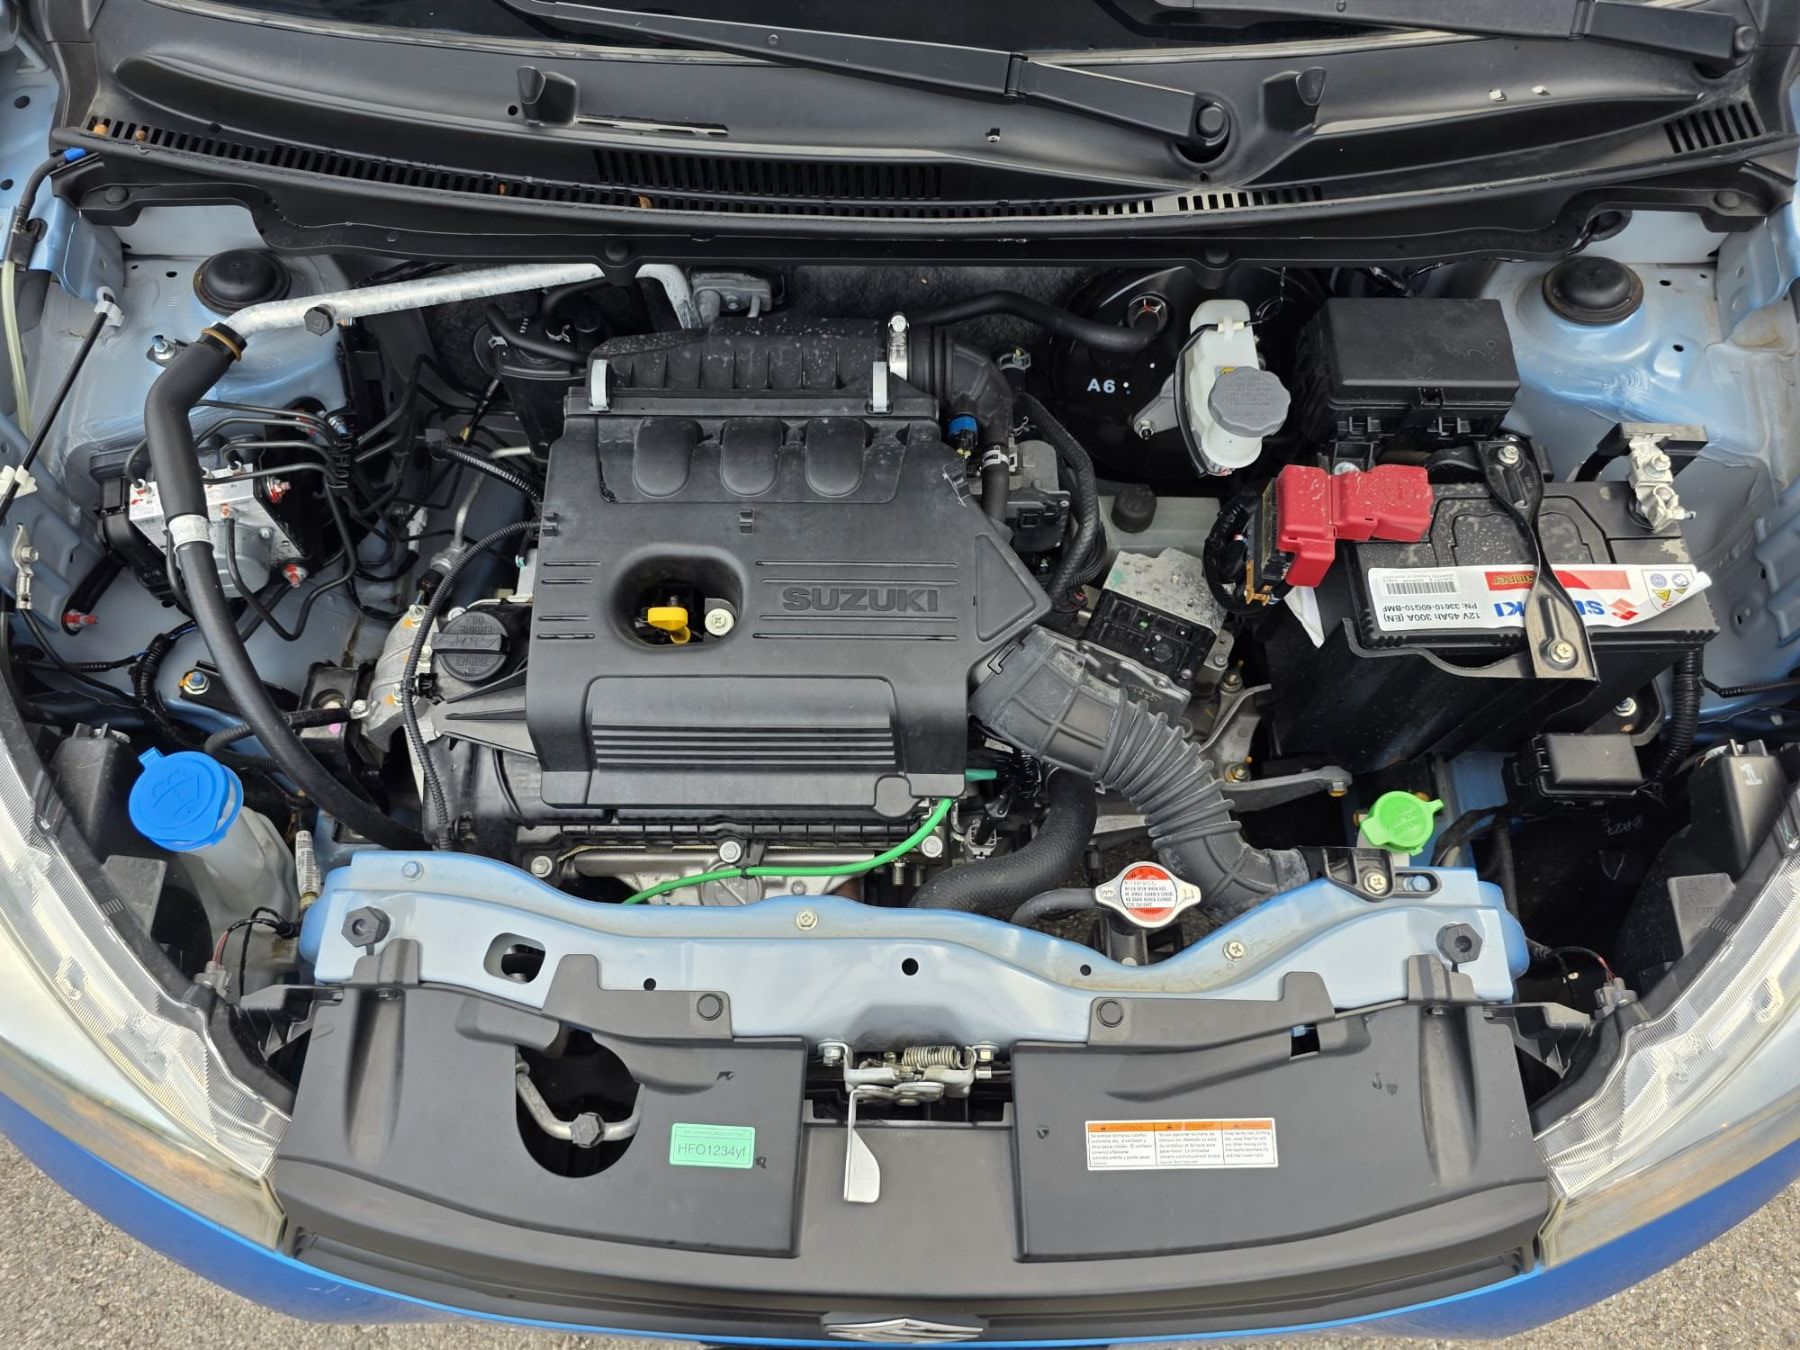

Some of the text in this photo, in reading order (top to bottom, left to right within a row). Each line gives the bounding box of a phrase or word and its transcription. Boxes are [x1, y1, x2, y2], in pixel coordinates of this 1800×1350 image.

[1086, 377, 1116, 394] A6
[1494, 574, 1534, 585] anner
[782, 587, 939, 612] SUZUKI
[1383, 611, 1481, 623] 12V 45Ah 300A (EN)
[1740, 763, 1763, 786] 1
[677, 1143, 746, 1159] HFO1234yf
